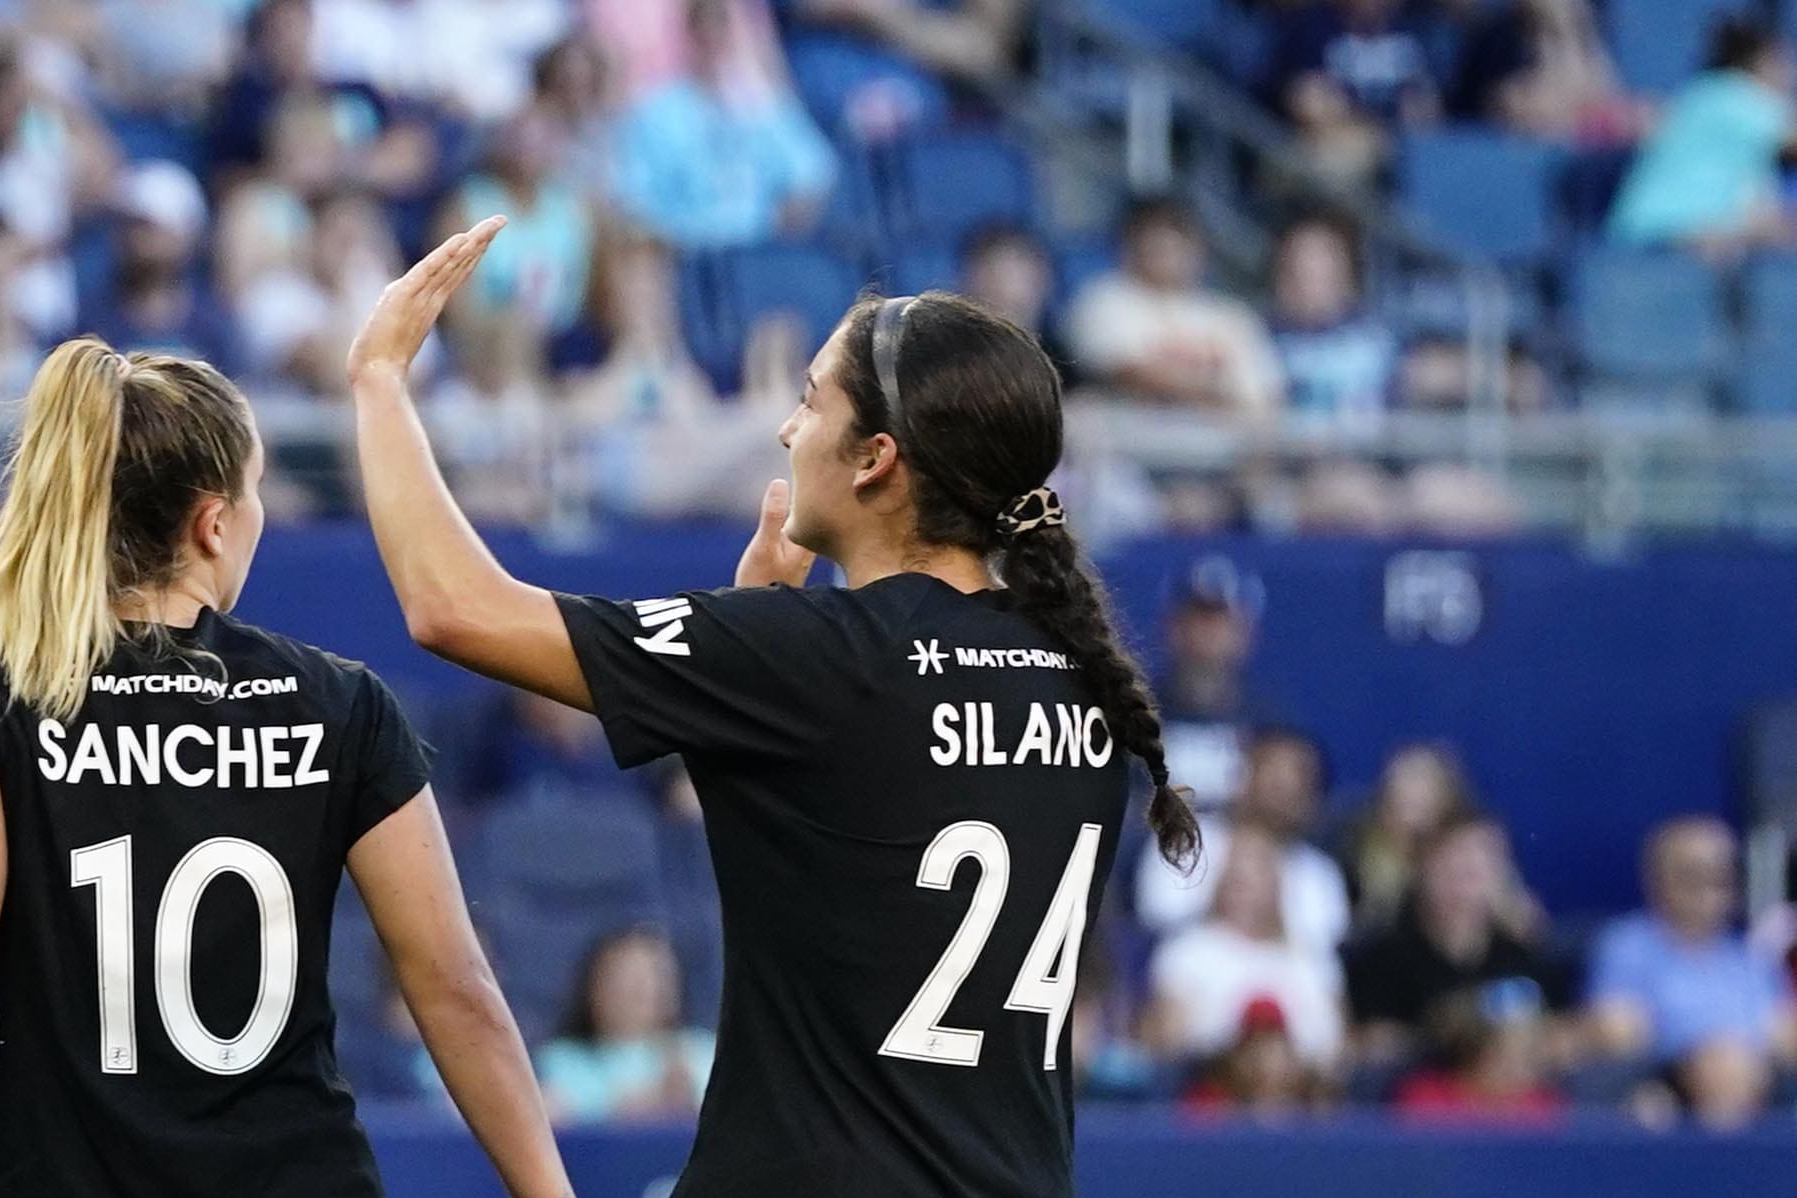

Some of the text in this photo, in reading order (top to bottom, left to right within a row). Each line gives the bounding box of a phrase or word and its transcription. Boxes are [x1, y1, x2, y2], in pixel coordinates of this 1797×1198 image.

[91, 674, 299, 700] MATCHDAY.COM
[38, 718, 331, 789] SANCHEZ
[929, 701, 1114, 769] SILANO
[69, 833, 299, 1076] 10
[877, 819, 1104, 1071] 24
